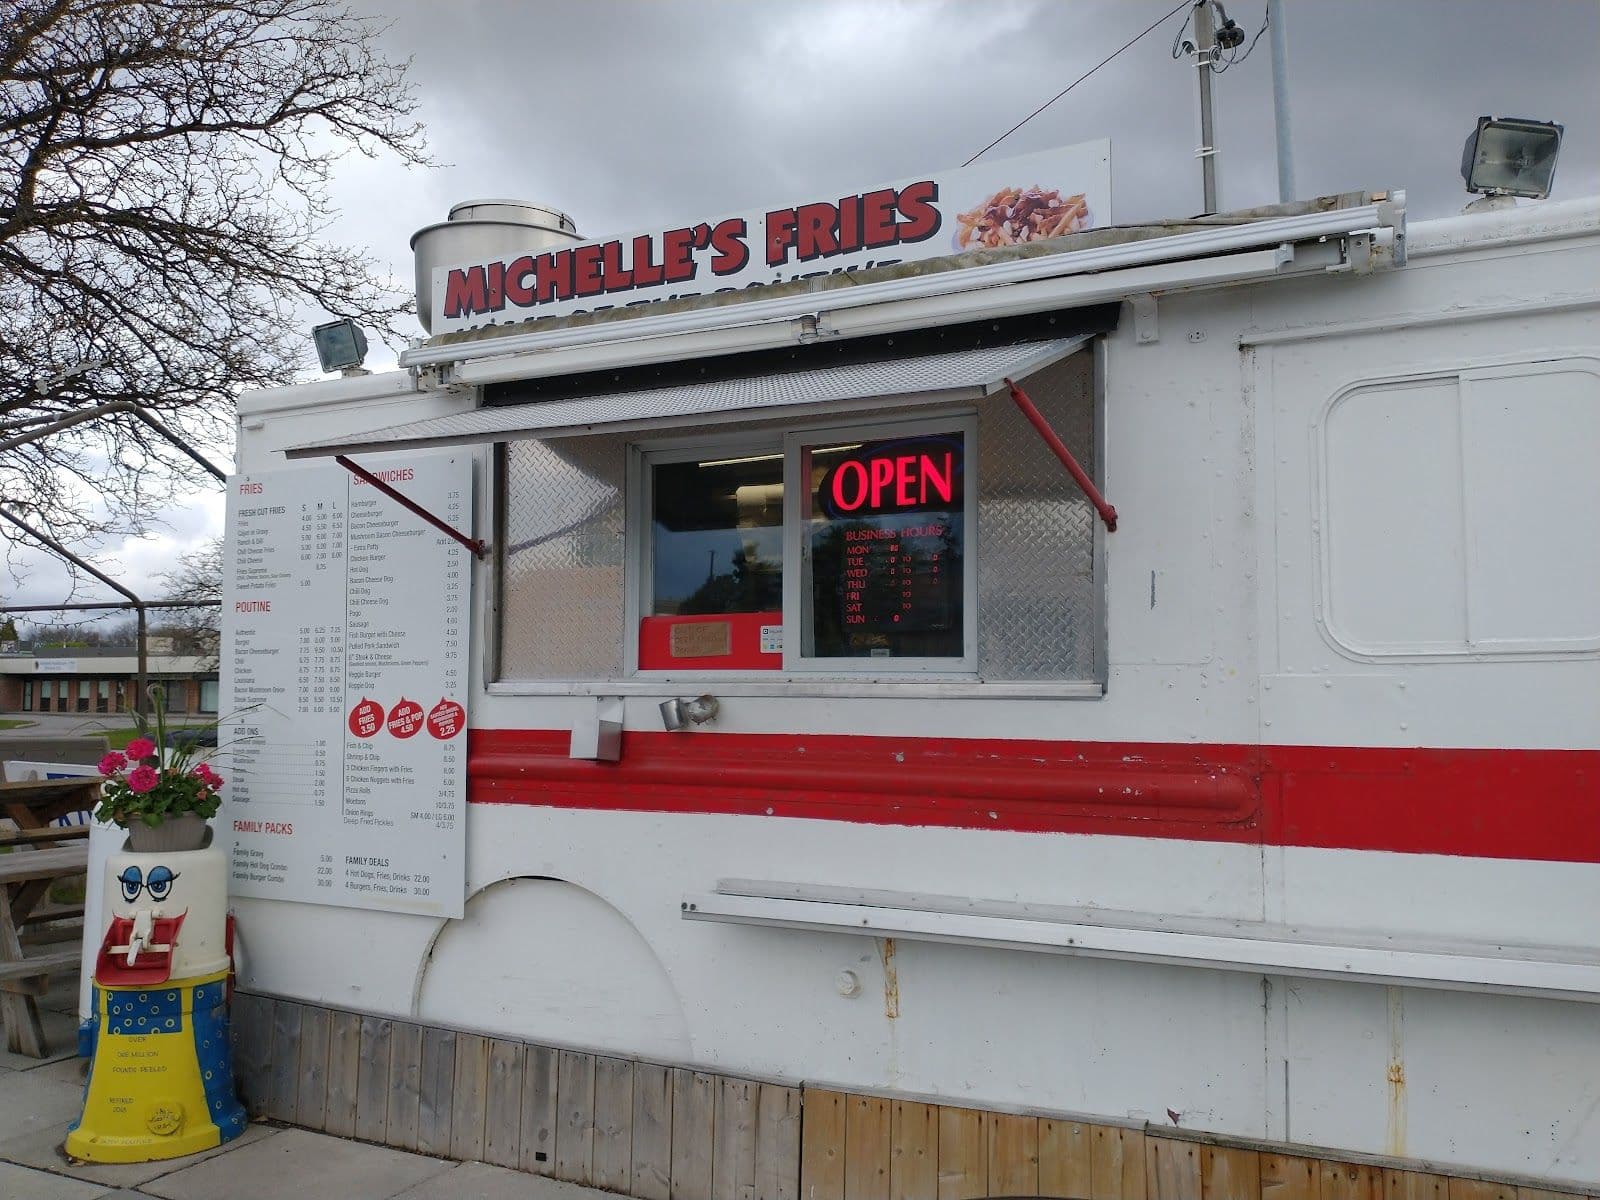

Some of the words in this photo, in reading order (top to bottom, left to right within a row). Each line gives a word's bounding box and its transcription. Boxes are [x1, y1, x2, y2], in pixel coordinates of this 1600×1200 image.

[443, 217, 748, 320] MICHELLE'S
[765, 181, 941, 267] FRIES
[832, 453, 952, 511] OPEN
[240, 483, 263, 495] FRIES
[239, 509, 255, 517] FRESH
[258, 508, 267, 516] CUT
[270, 506, 285, 515] FRIES
[302, 504, 306, 512] S
[351, 511, 383, 519] Cheeseburger
[846, 529, 896, 541] BUSINESS
[901, 525, 943, 537] HOURS
[847, 545, 869, 554] MON
[848, 557, 864, 566] TUE
[847, 569, 868, 577] WED
[848, 581, 865, 589] THU
[847, 592, 859, 600] FRI
[236, 601, 271, 613] POUTINE
[847, 603, 862, 612] SAT
[847, 615, 865, 623] SUN
[360, 705, 371, 715] ADD
[399, 707, 410, 717] ADD
[359, 714, 374, 725] FRIES
[388, 718, 405, 729] FRIES
[412, 712, 423, 722] POP
[361, 723, 375, 734] 3.50
[401, 724, 413, 733] 4.50
[440, 725, 455, 736] 2.25
[233, 821, 262, 832] FAMILY
[265, 822, 292, 835] PACKS
[233, 848, 249, 857] Family
[250, 850, 263, 858] Gravy
[233, 860, 248, 869] Family
[346, 856, 367, 865] FAMILY
[369, 858, 389, 867] DEALS
[233, 872, 248, 880] Family
[393, 873, 410, 881] Drinks
[414, 875, 429, 883] 22.00
[390, 885, 407, 894] Drinks
[414, 887, 429, 895] 30.00
